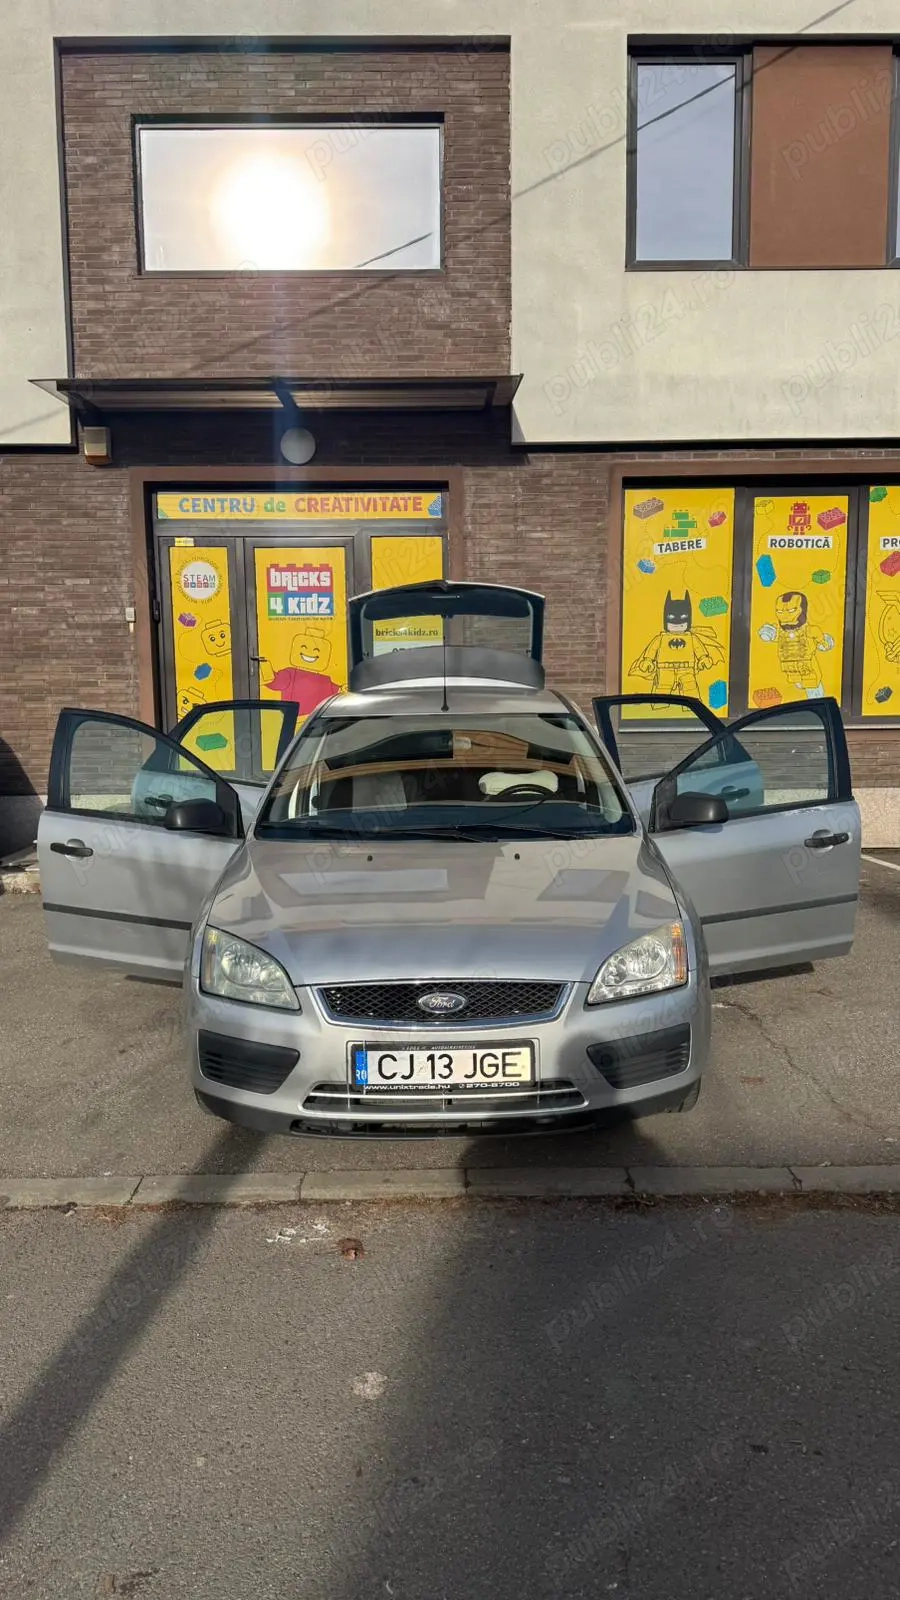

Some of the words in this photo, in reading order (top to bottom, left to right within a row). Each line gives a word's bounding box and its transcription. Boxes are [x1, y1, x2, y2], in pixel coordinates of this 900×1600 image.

[178, 497, 255, 513] CENTRU
[263, 497, 286, 513] de
[294, 496, 424, 513] CREATIVITATE
[657, 538, 703, 553] TABERE
[882, 537, 900, 548] PR
[183, 574, 216, 582] STEAM
[269, 597, 284, 614] 4
[430, 996, 456, 1008] Ford
[377, 1053, 414, 1080] CJ
[426, 1053, 454, 1080] 13
[463, 1051, 523, 1079] JGE
